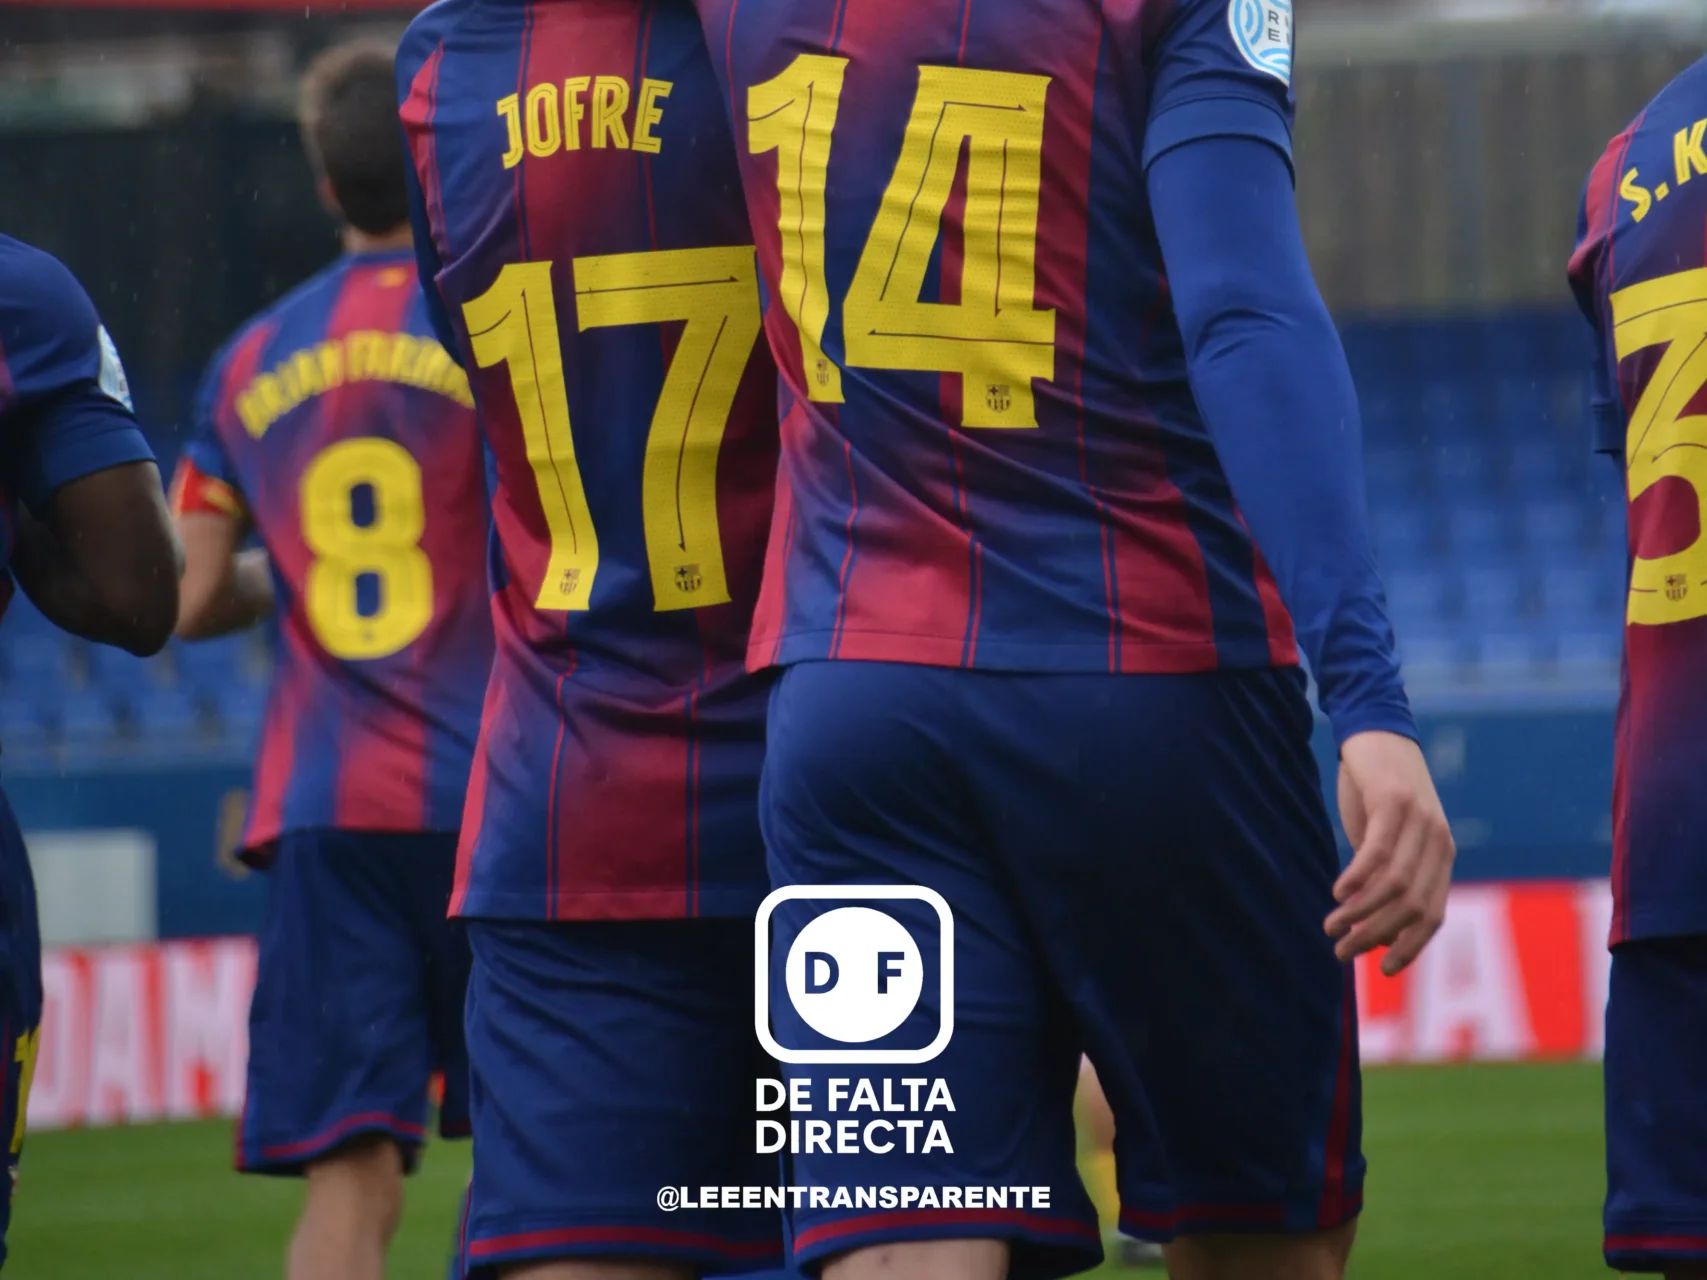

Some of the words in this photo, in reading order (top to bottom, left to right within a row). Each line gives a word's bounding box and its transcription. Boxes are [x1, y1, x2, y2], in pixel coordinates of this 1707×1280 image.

[497, 75, 674, 169] JOFRE
[746, 53, 1057, 429] 14
[300, 436, 434, 659] 8
[461, 245, 763, 612] 17
